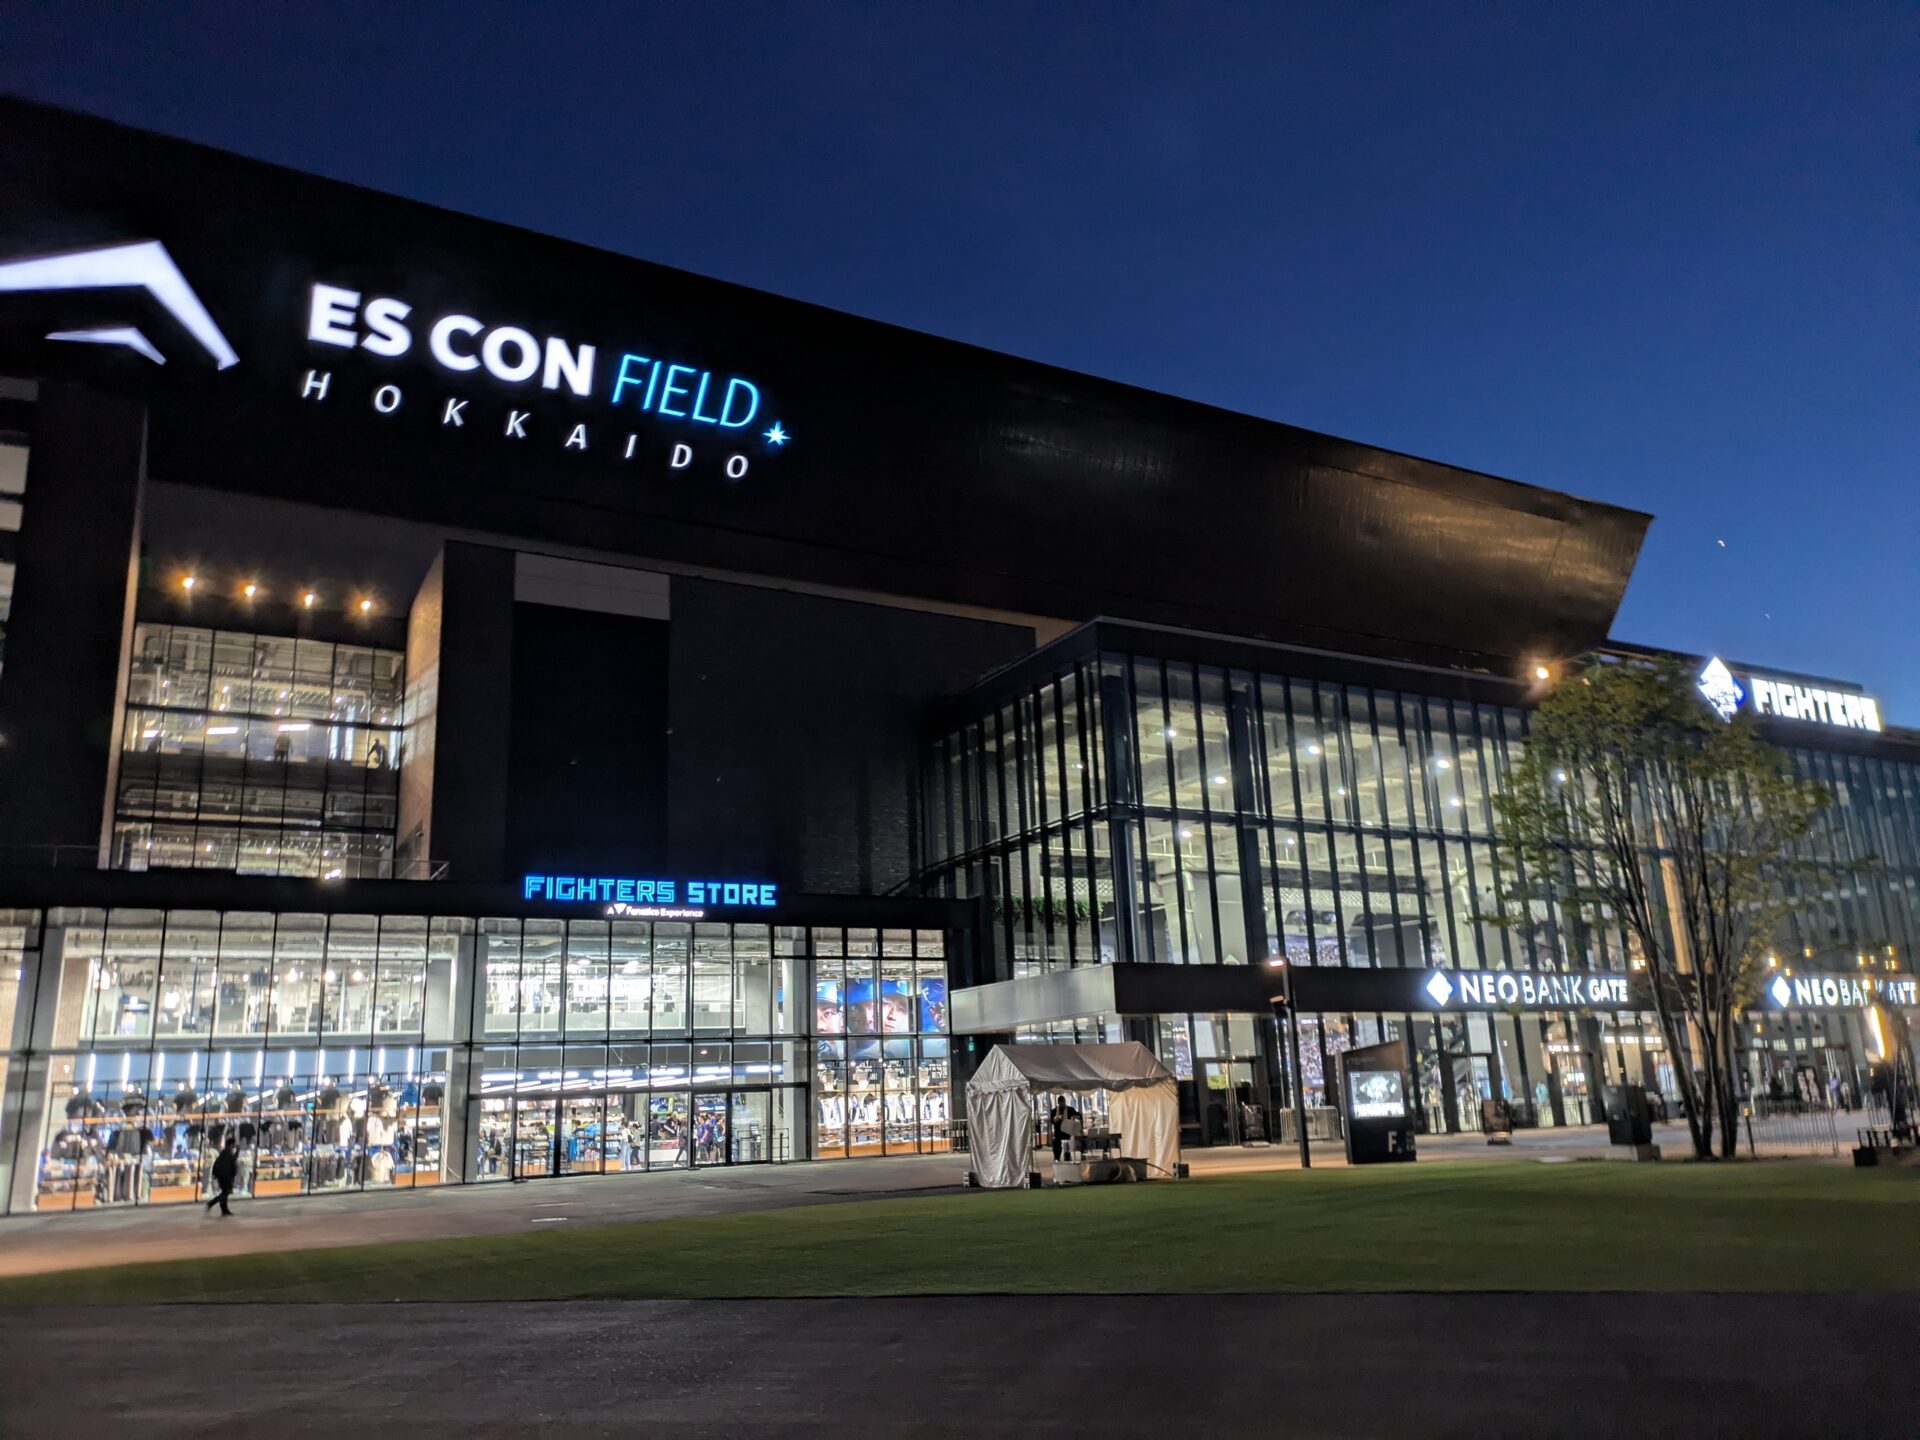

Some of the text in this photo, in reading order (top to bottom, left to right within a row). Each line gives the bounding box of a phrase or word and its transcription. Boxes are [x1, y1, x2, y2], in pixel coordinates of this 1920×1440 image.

[307, 282, 761, 430] ES CON FIELD
[301, 368, 749, 479] HOKKAIDO
[523, 873, 777, 906] FIGHTERS STORE
[606, 905, 615, 915] A
[1588, 978, 1628, 1003] GATE
